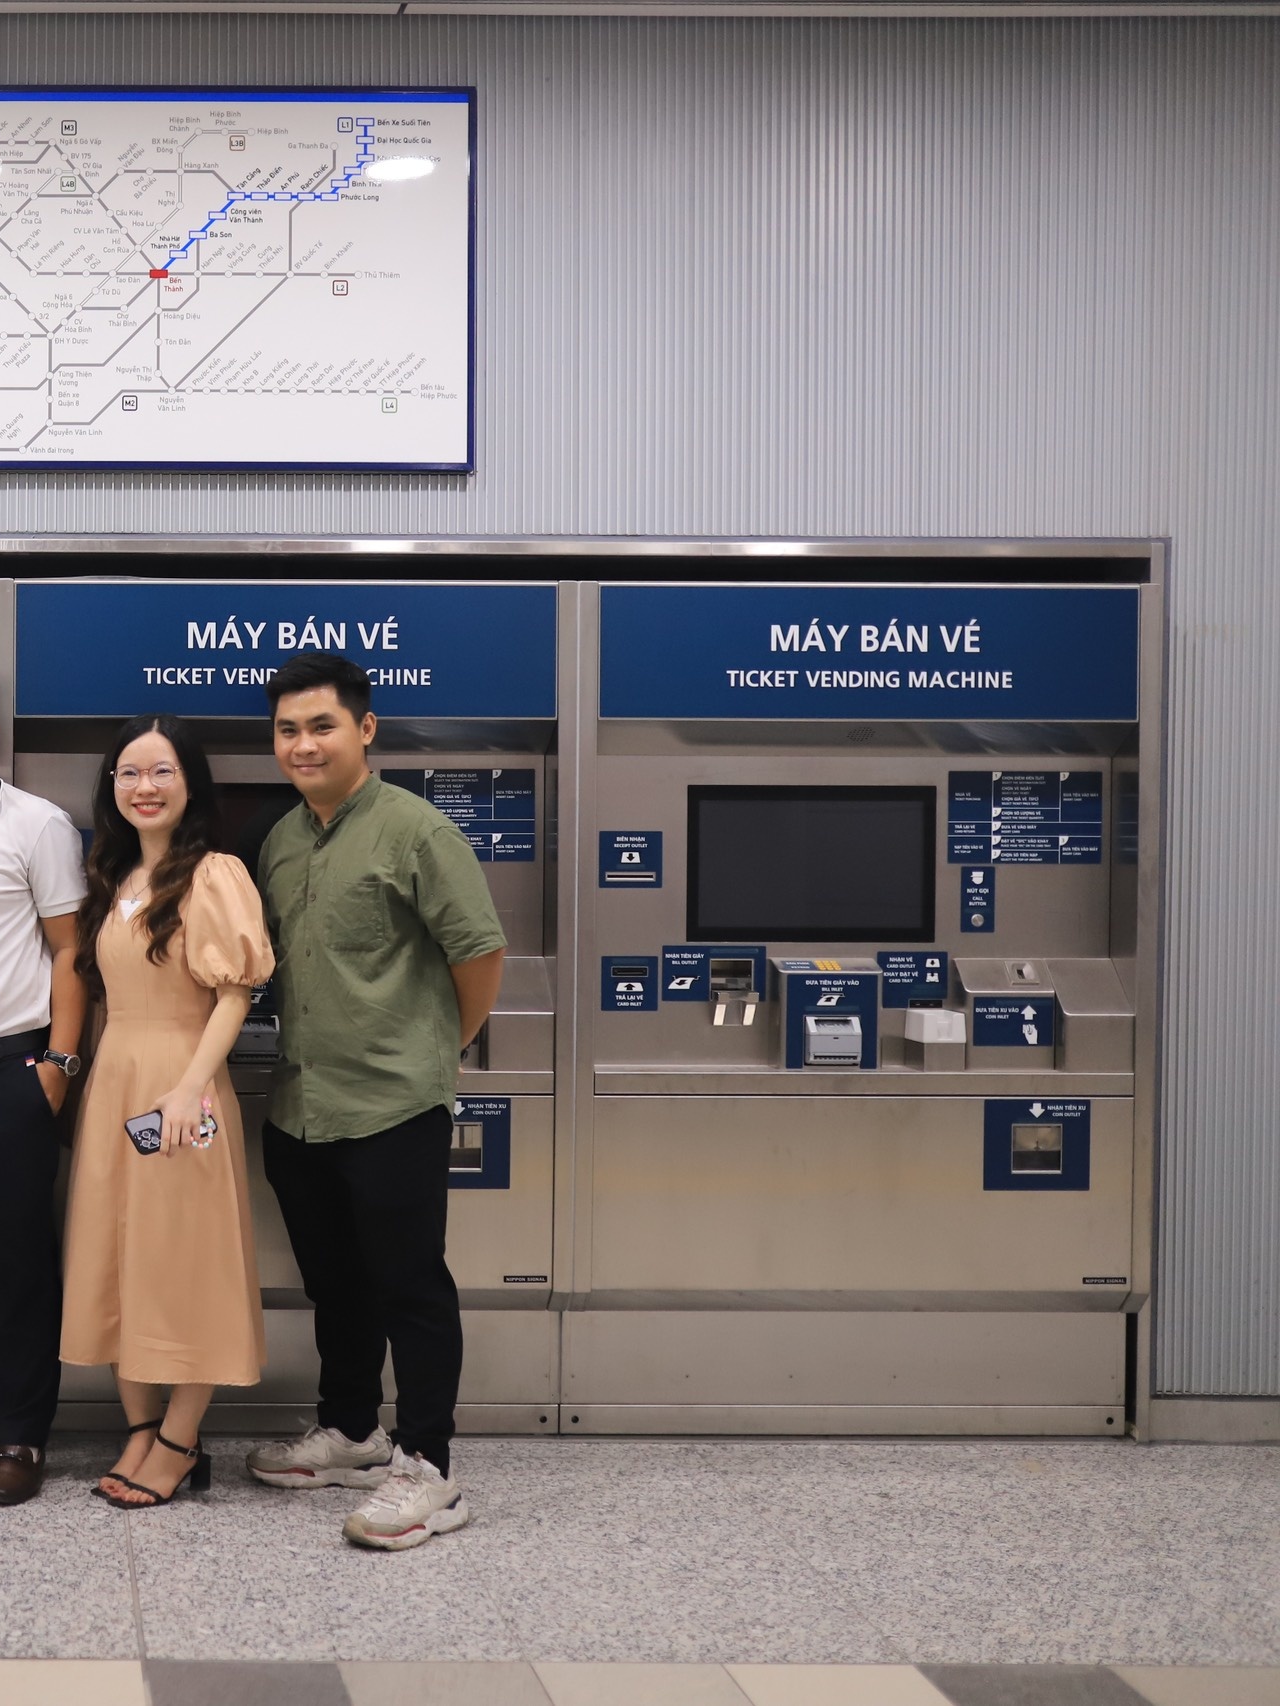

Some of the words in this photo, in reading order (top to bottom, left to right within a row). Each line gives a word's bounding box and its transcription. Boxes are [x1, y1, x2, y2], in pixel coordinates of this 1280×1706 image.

[188, 616, 266, 648] MÁY
[279, 616, 345, 649] BÁN
[358, 616, 398, 649] VÉ
[771, 618, 849, 651] MÁY
[861, 619, 928, 652] BÁN
[940, 619, 980, 652] VÉ
[143, 668, 216, 685] TICKET
[365, 668, 431, 685] CHINE
[726, 670, 798, 687] TICKET
[806, 671, 899, 688] VENDING
[909, 672, 1012, 688] MACHINE
